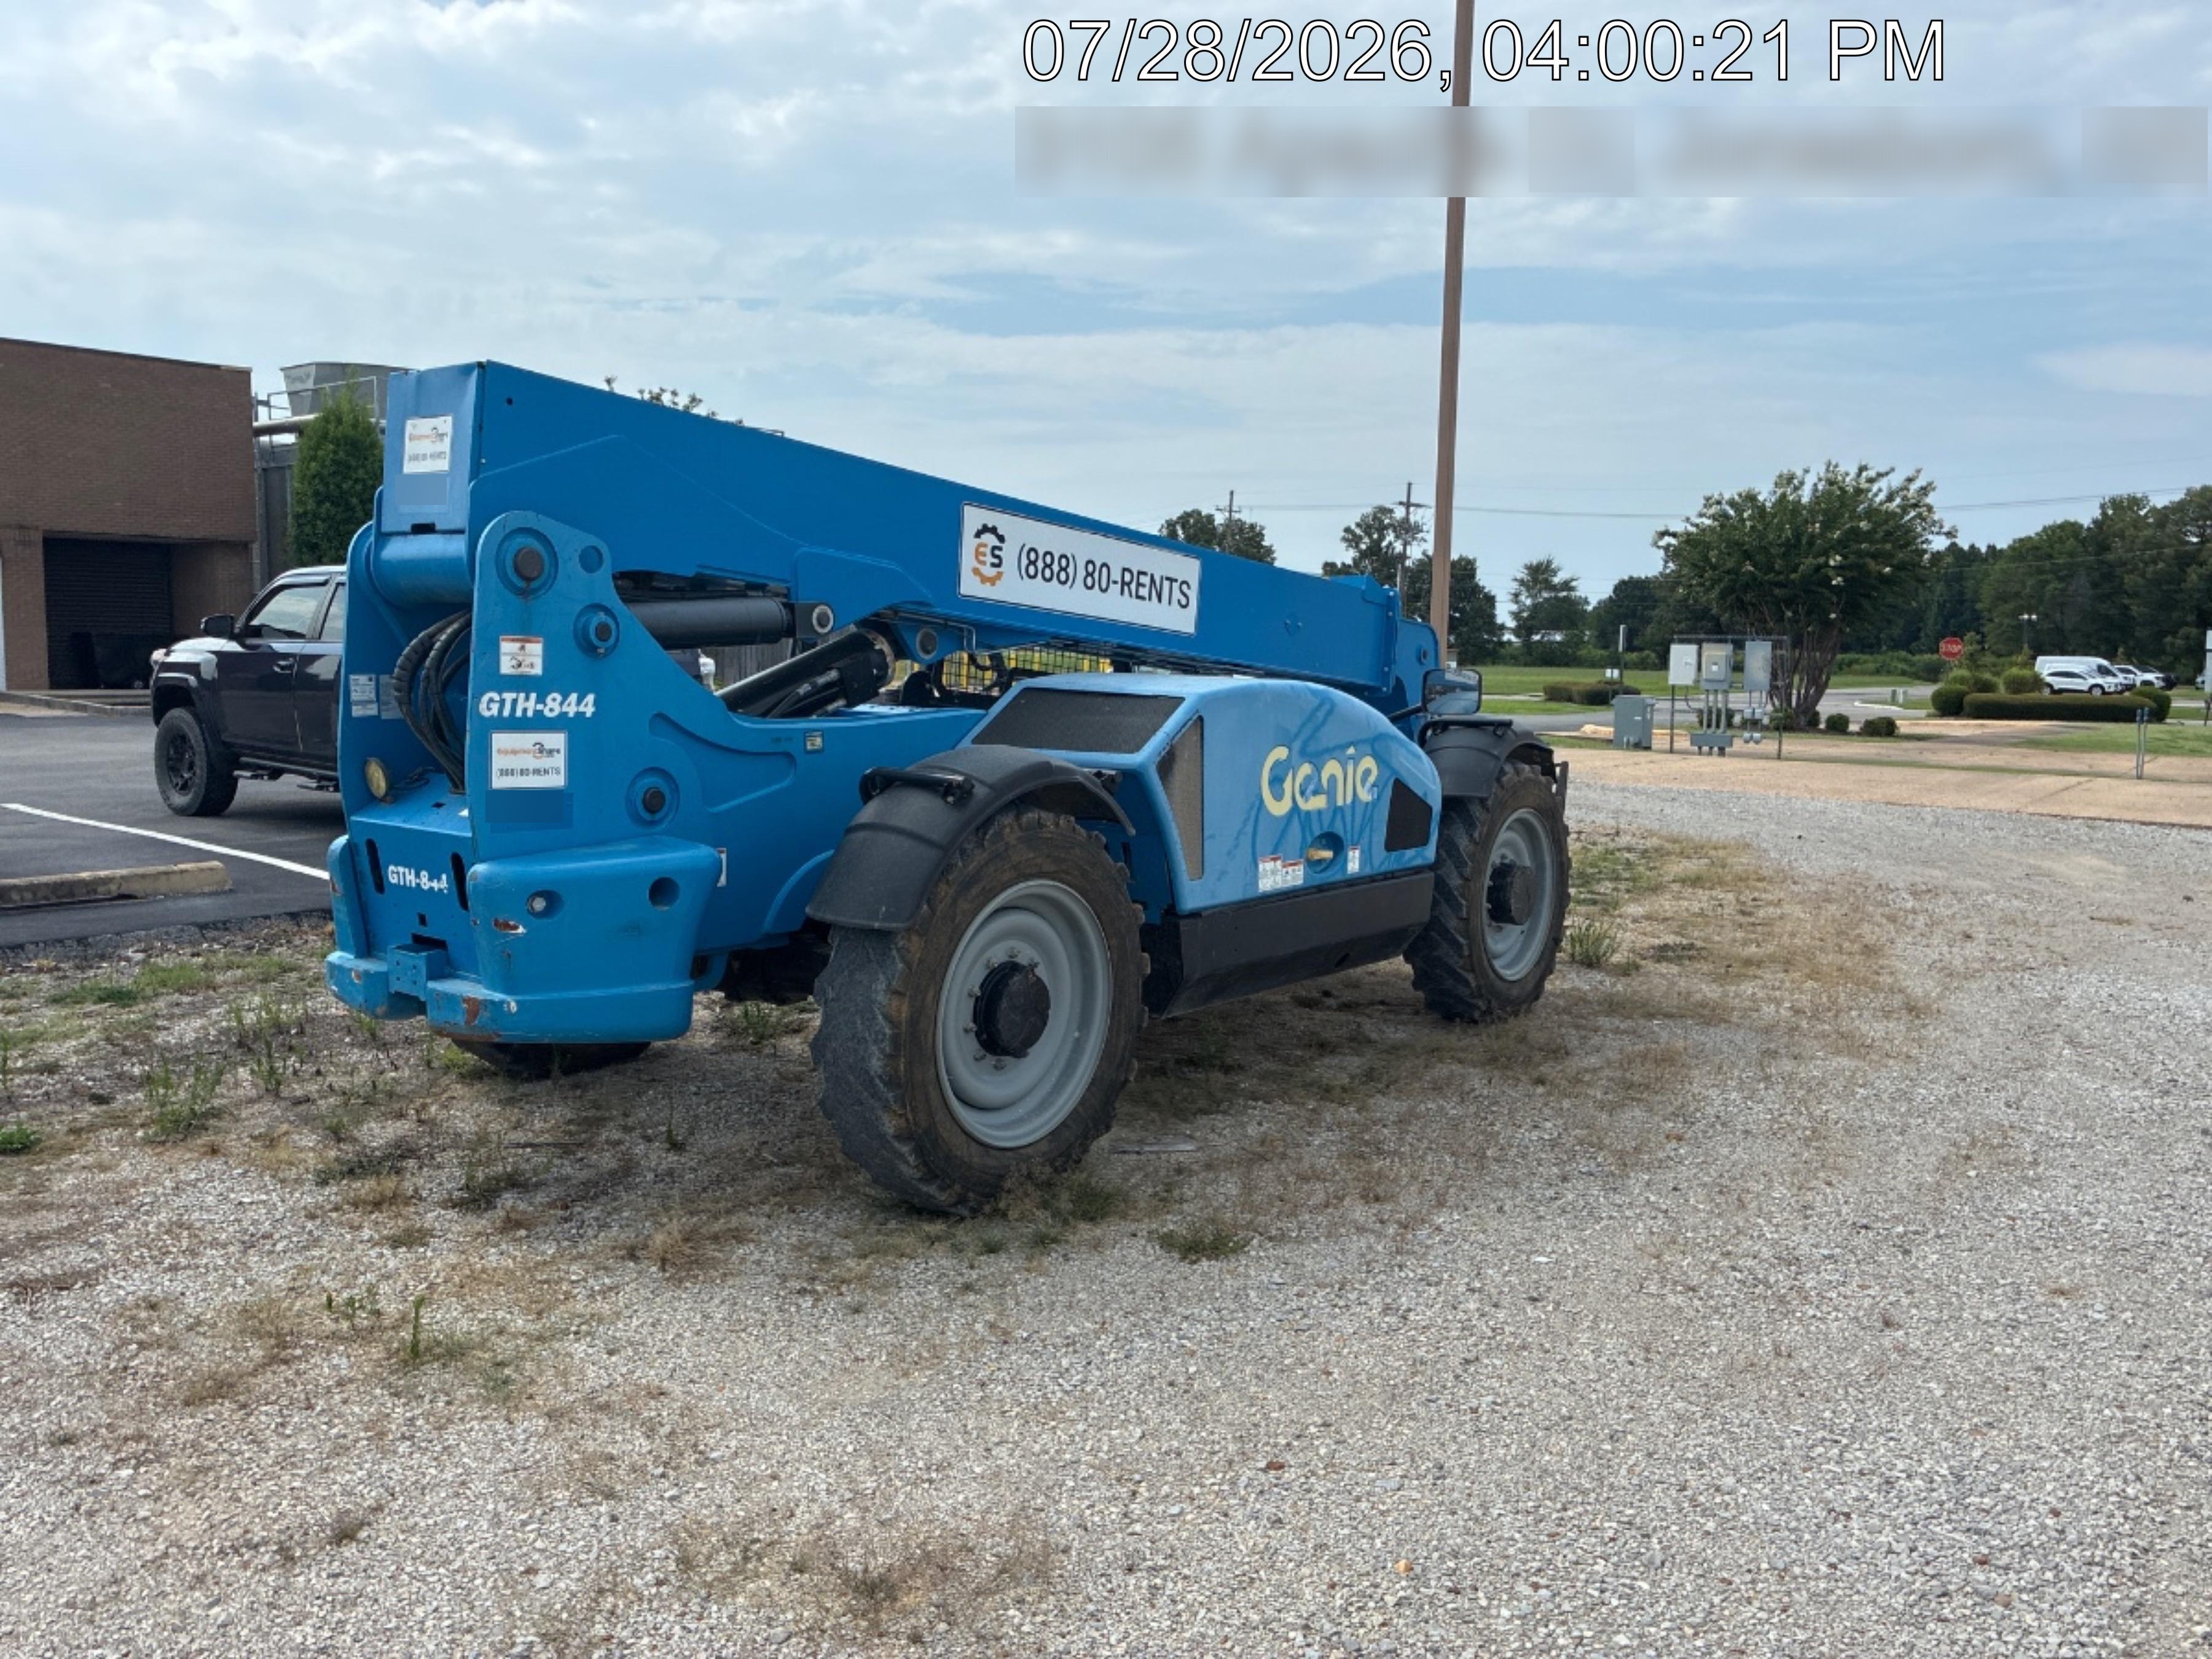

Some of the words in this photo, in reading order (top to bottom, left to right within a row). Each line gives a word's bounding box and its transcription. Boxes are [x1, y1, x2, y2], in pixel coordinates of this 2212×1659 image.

[1017, 544, 1077, 589] (888)
[1083, 560, 1191, 609] 80-RENTS
[479, 691, 596, 718] GTH-844
[1261, 745, 1378, 815] Genie
